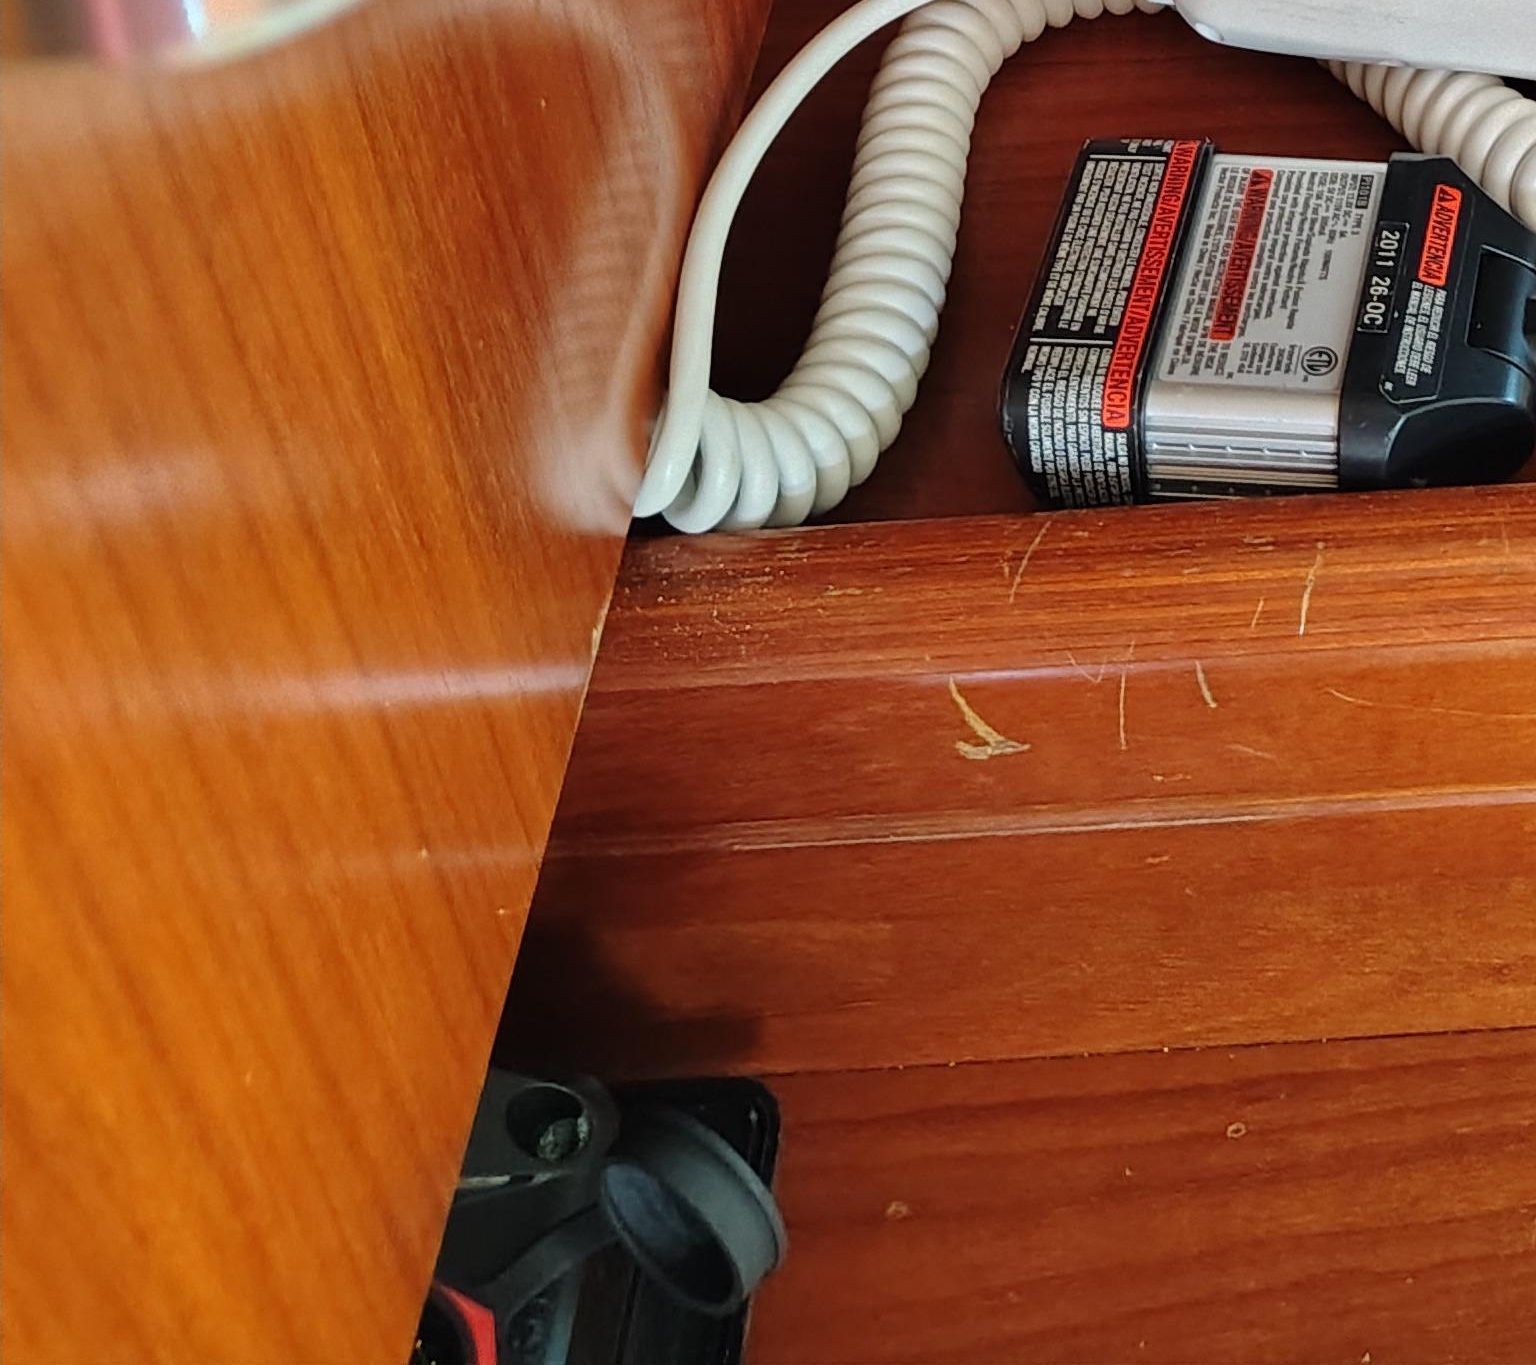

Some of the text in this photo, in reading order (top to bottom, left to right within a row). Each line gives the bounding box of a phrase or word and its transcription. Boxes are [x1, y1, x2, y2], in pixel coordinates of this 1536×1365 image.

[1107, 147, 1197, 426] WARNING/AVERTISSEMENT/ADVERTENCIA
[1364, 231, 1400, 326] 2011 26-OC
[1420, 204, 1458, 282] ADVERTENCIA
